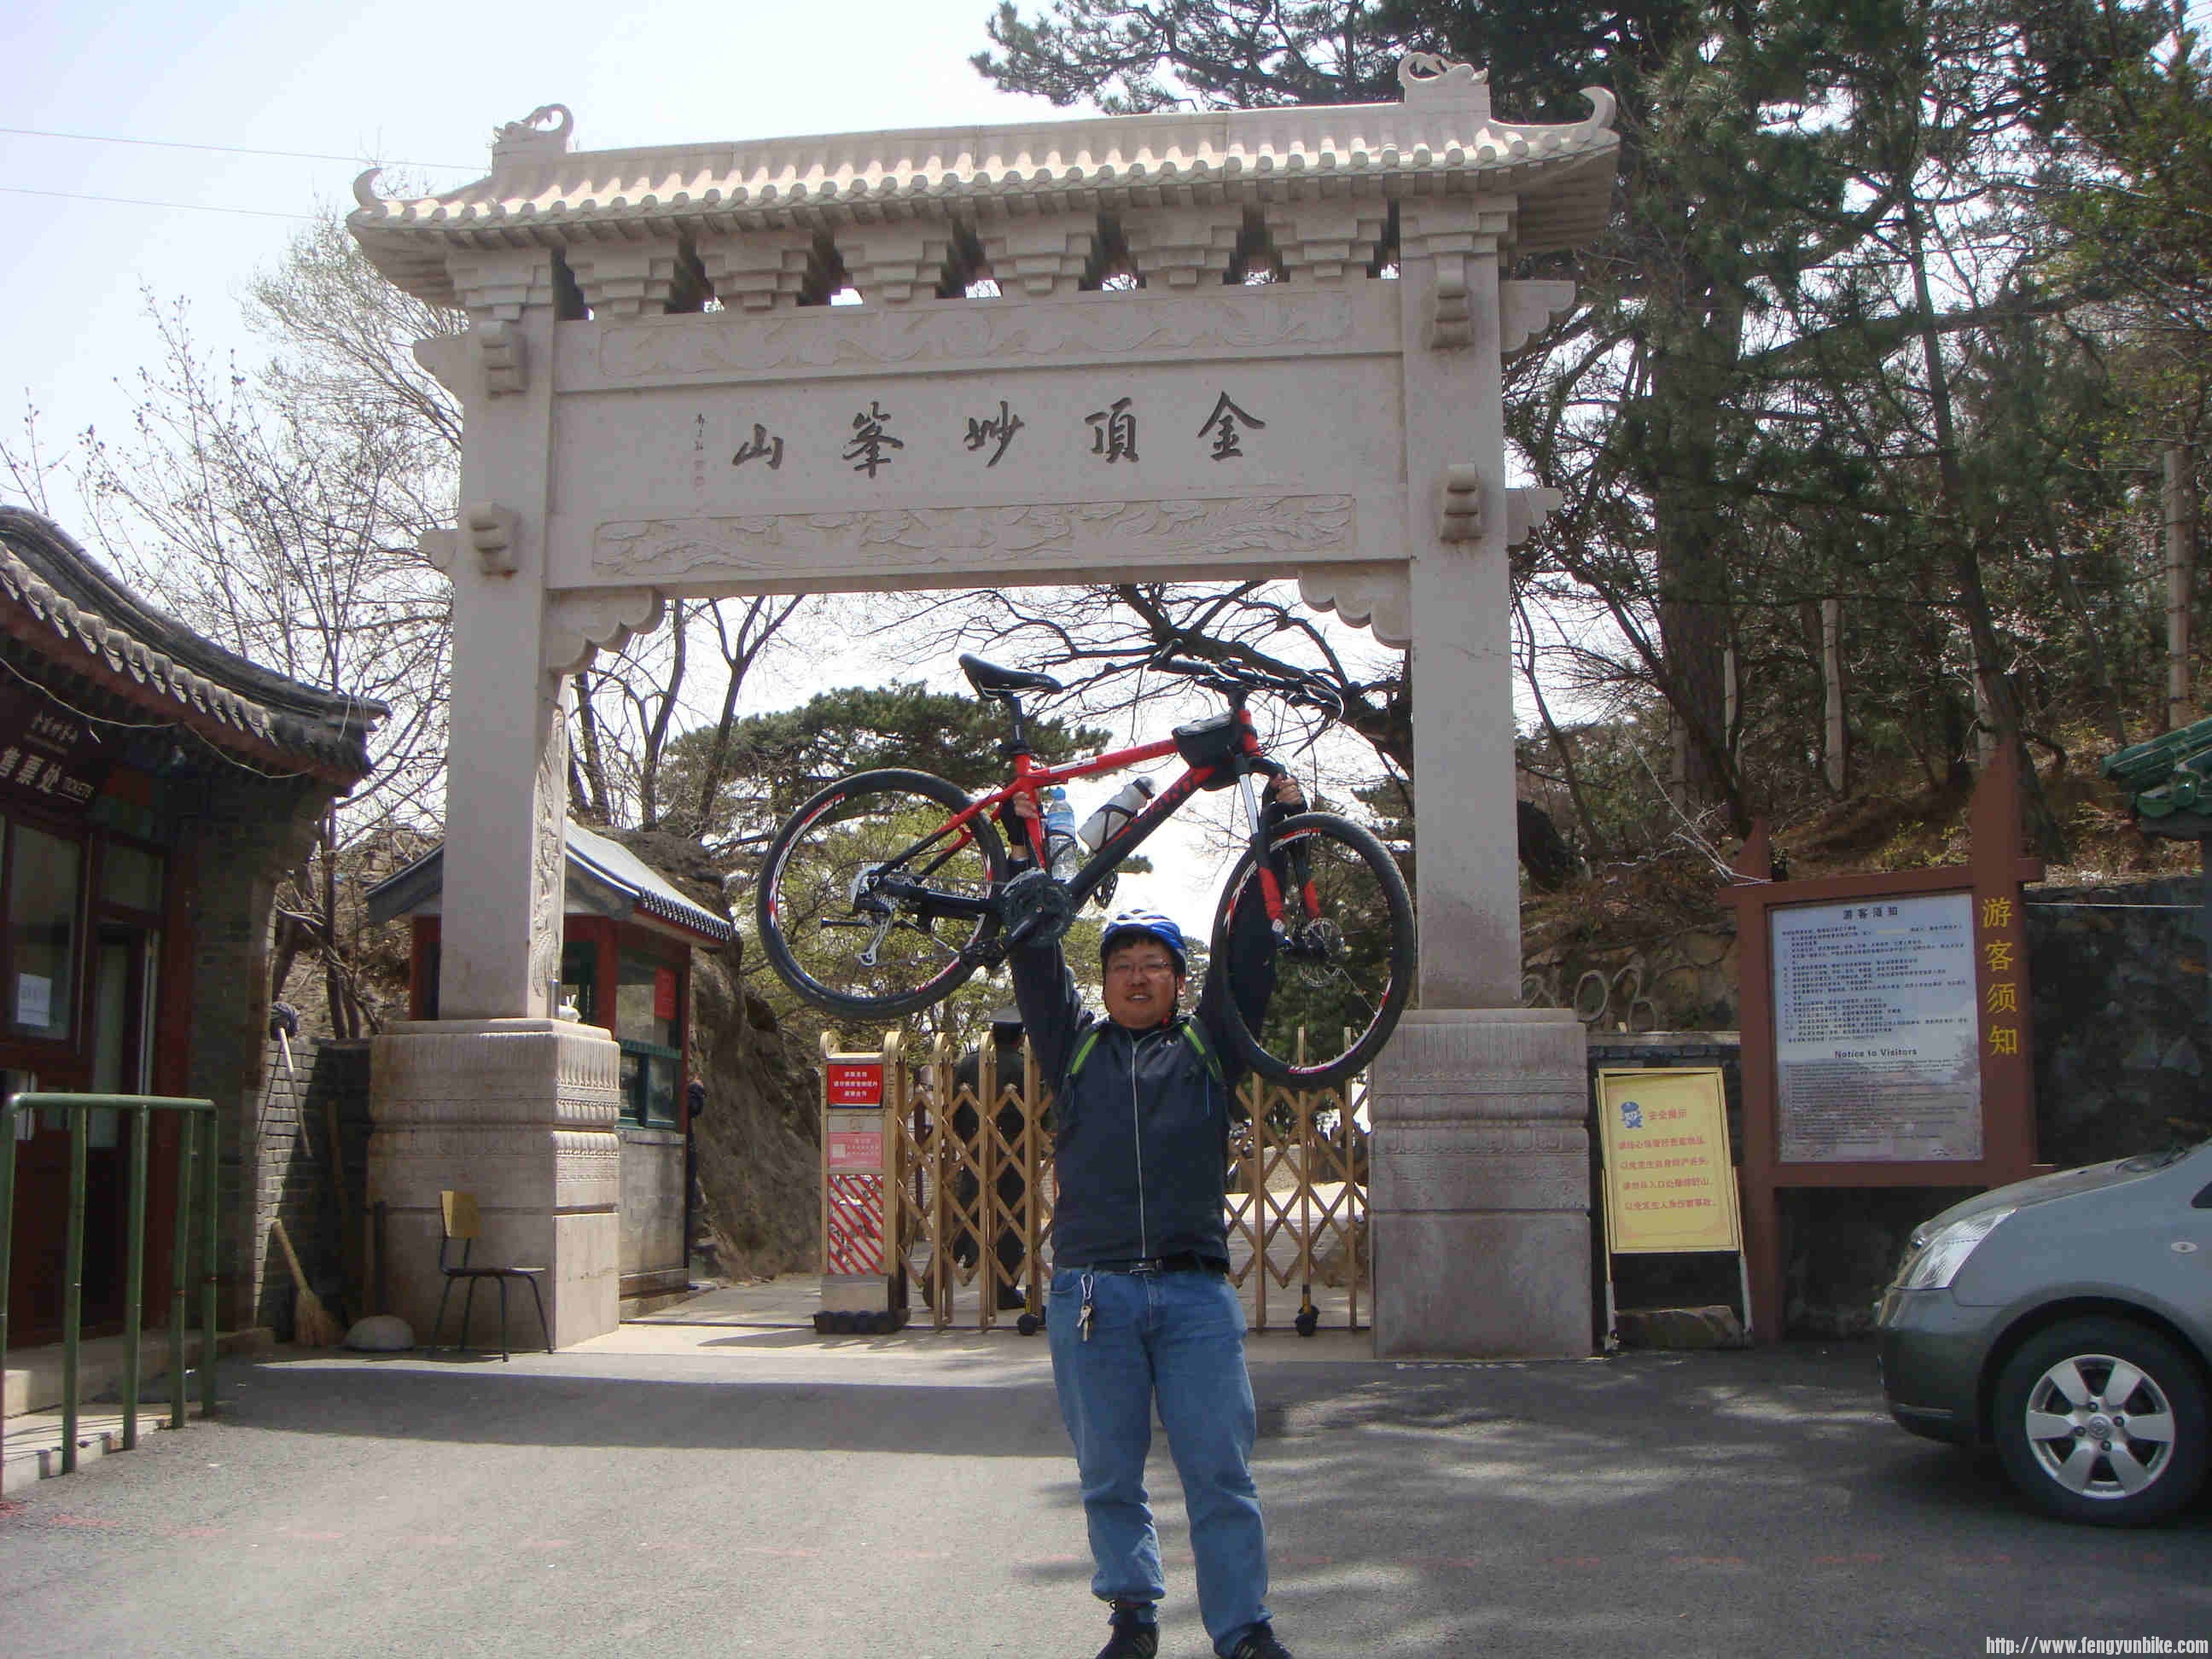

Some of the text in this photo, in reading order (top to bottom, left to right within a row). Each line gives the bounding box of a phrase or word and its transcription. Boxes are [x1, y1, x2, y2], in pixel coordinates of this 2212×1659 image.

[1842, 906, 1899, 920] 游客须知
[1982, 897, 2019, 1057] 游客须知
[1835, 1048, 1918, 1059] Notice to Visitors
